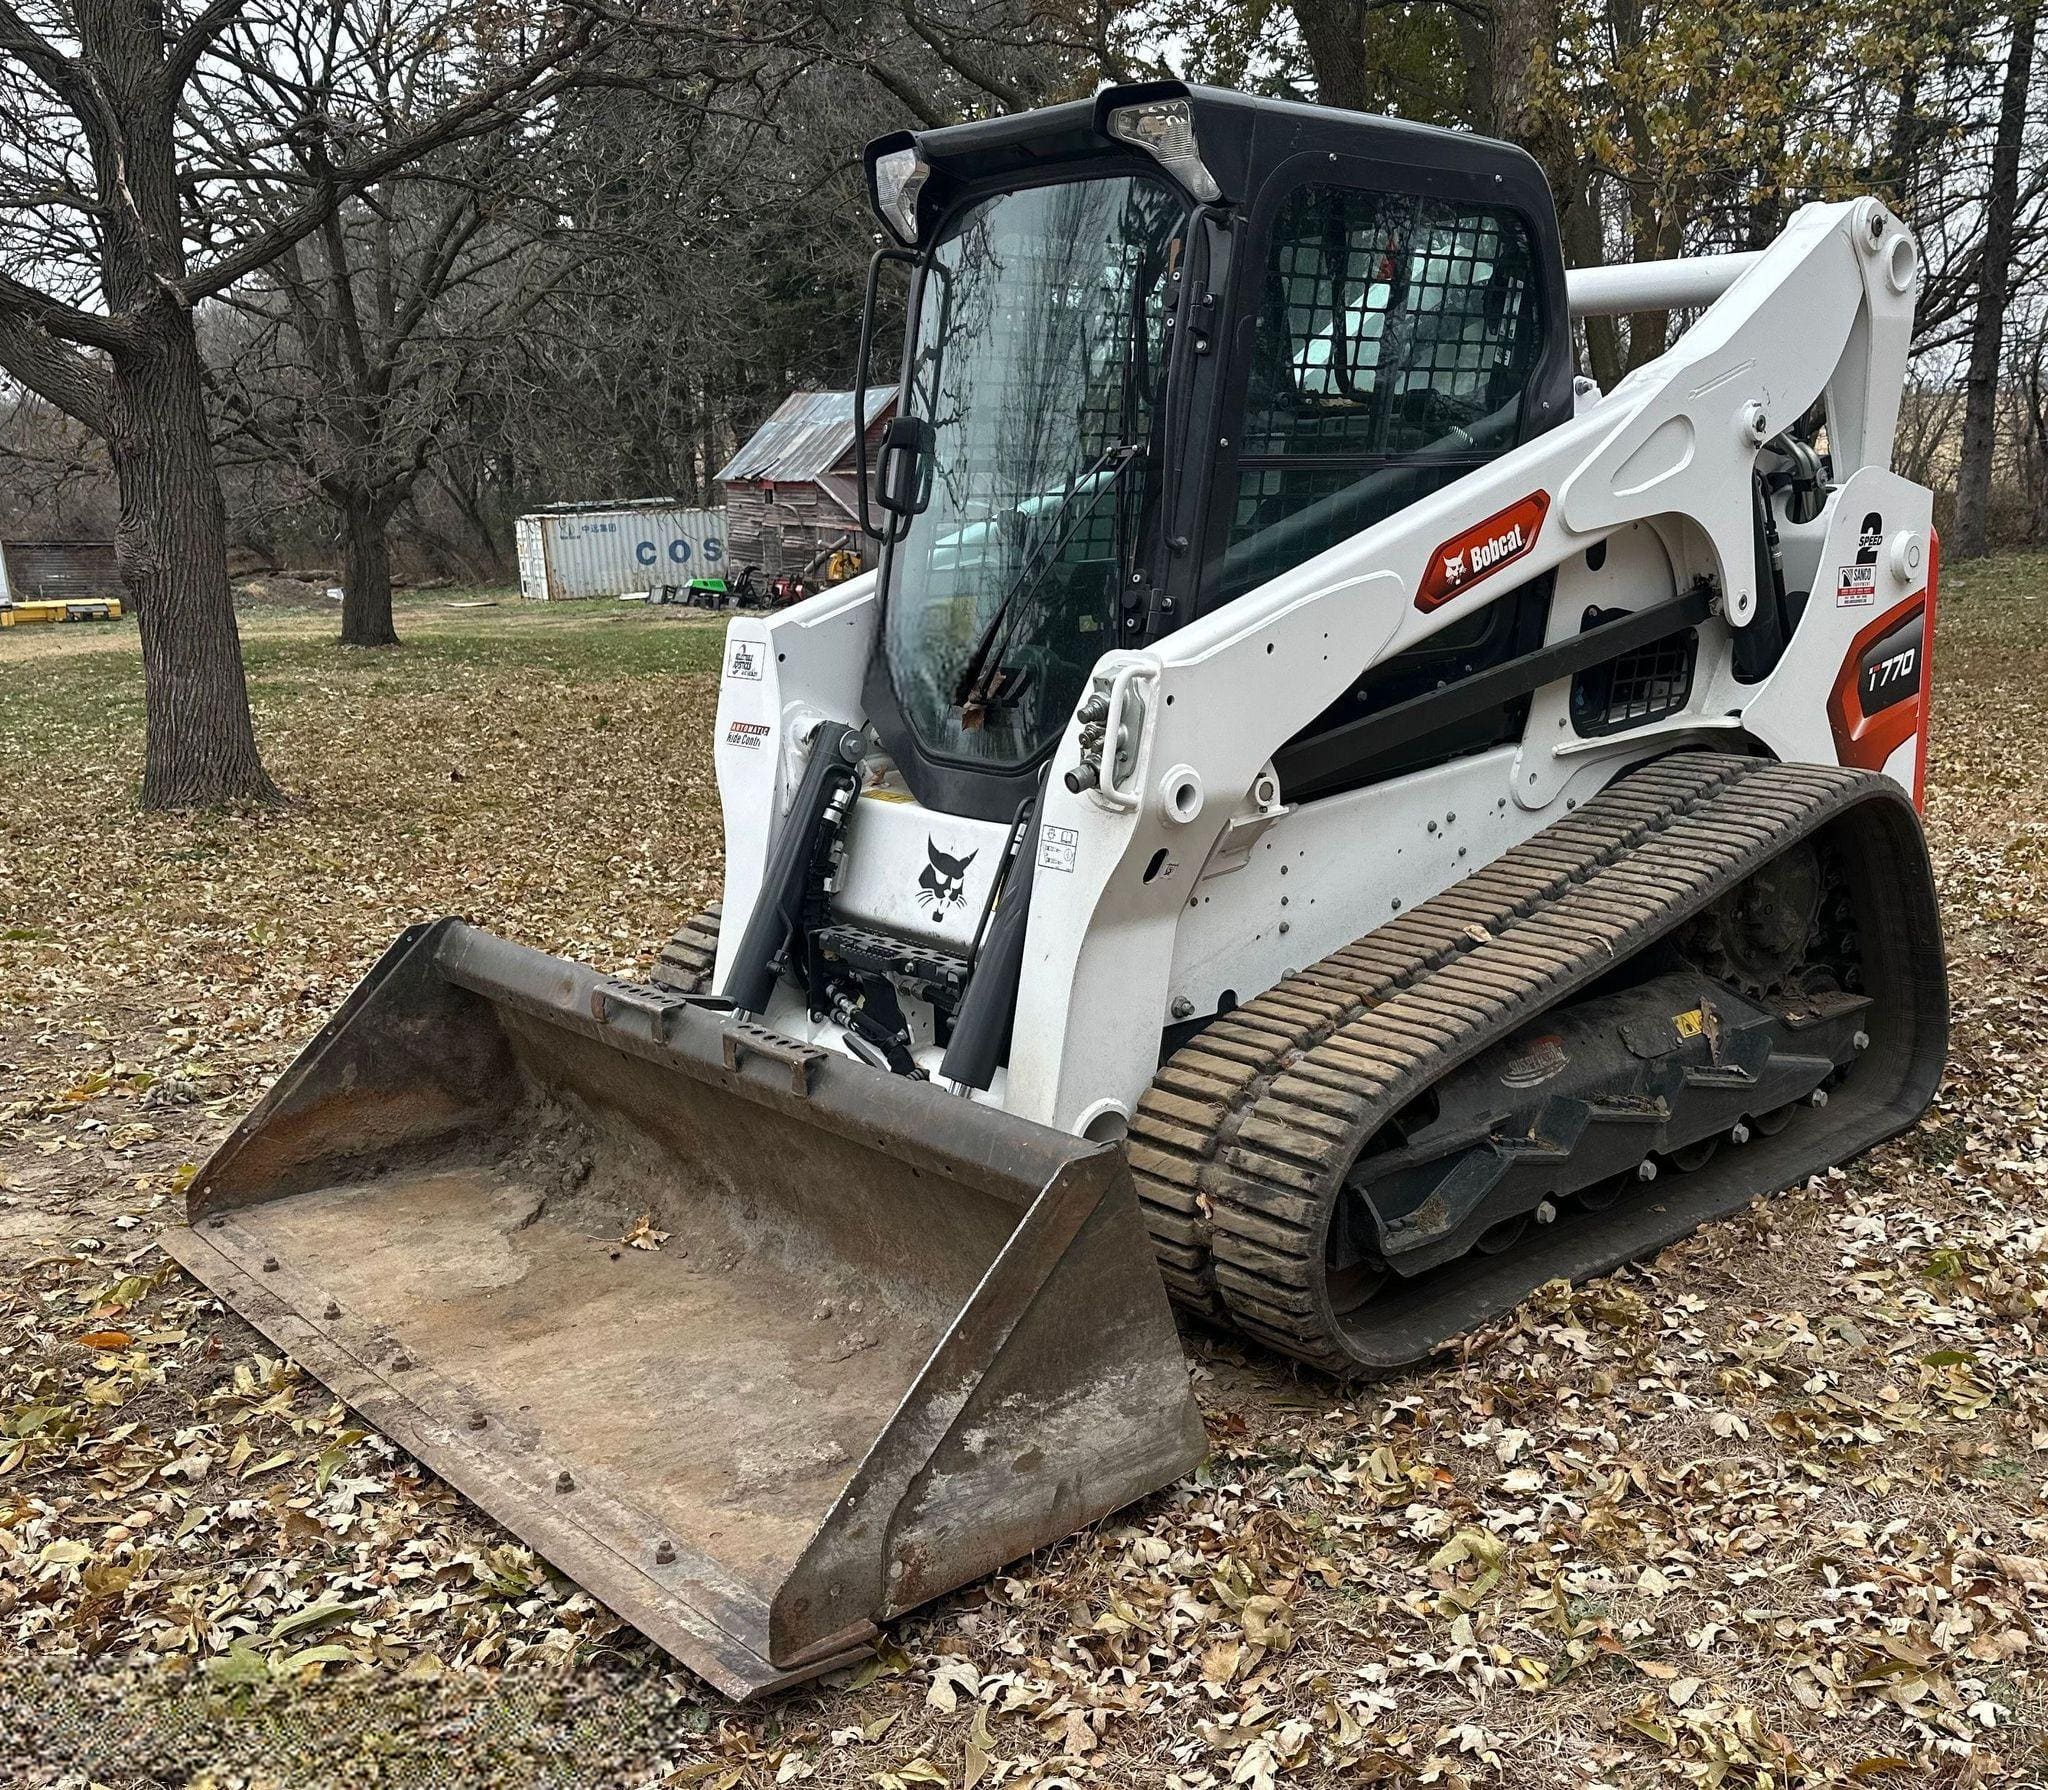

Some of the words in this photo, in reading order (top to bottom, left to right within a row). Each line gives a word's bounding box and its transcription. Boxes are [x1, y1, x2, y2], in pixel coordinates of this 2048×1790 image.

[635, 537, 723, 566] COS
[1469, 523, 1523, 573] Bobcat
[1856, 512, 1882, 565] 2
[1858, 535, 1883, 547] SPEED
[1868, 648, 1915, 692] T770
[731, 722, 769, 737] AUTOMATIC
